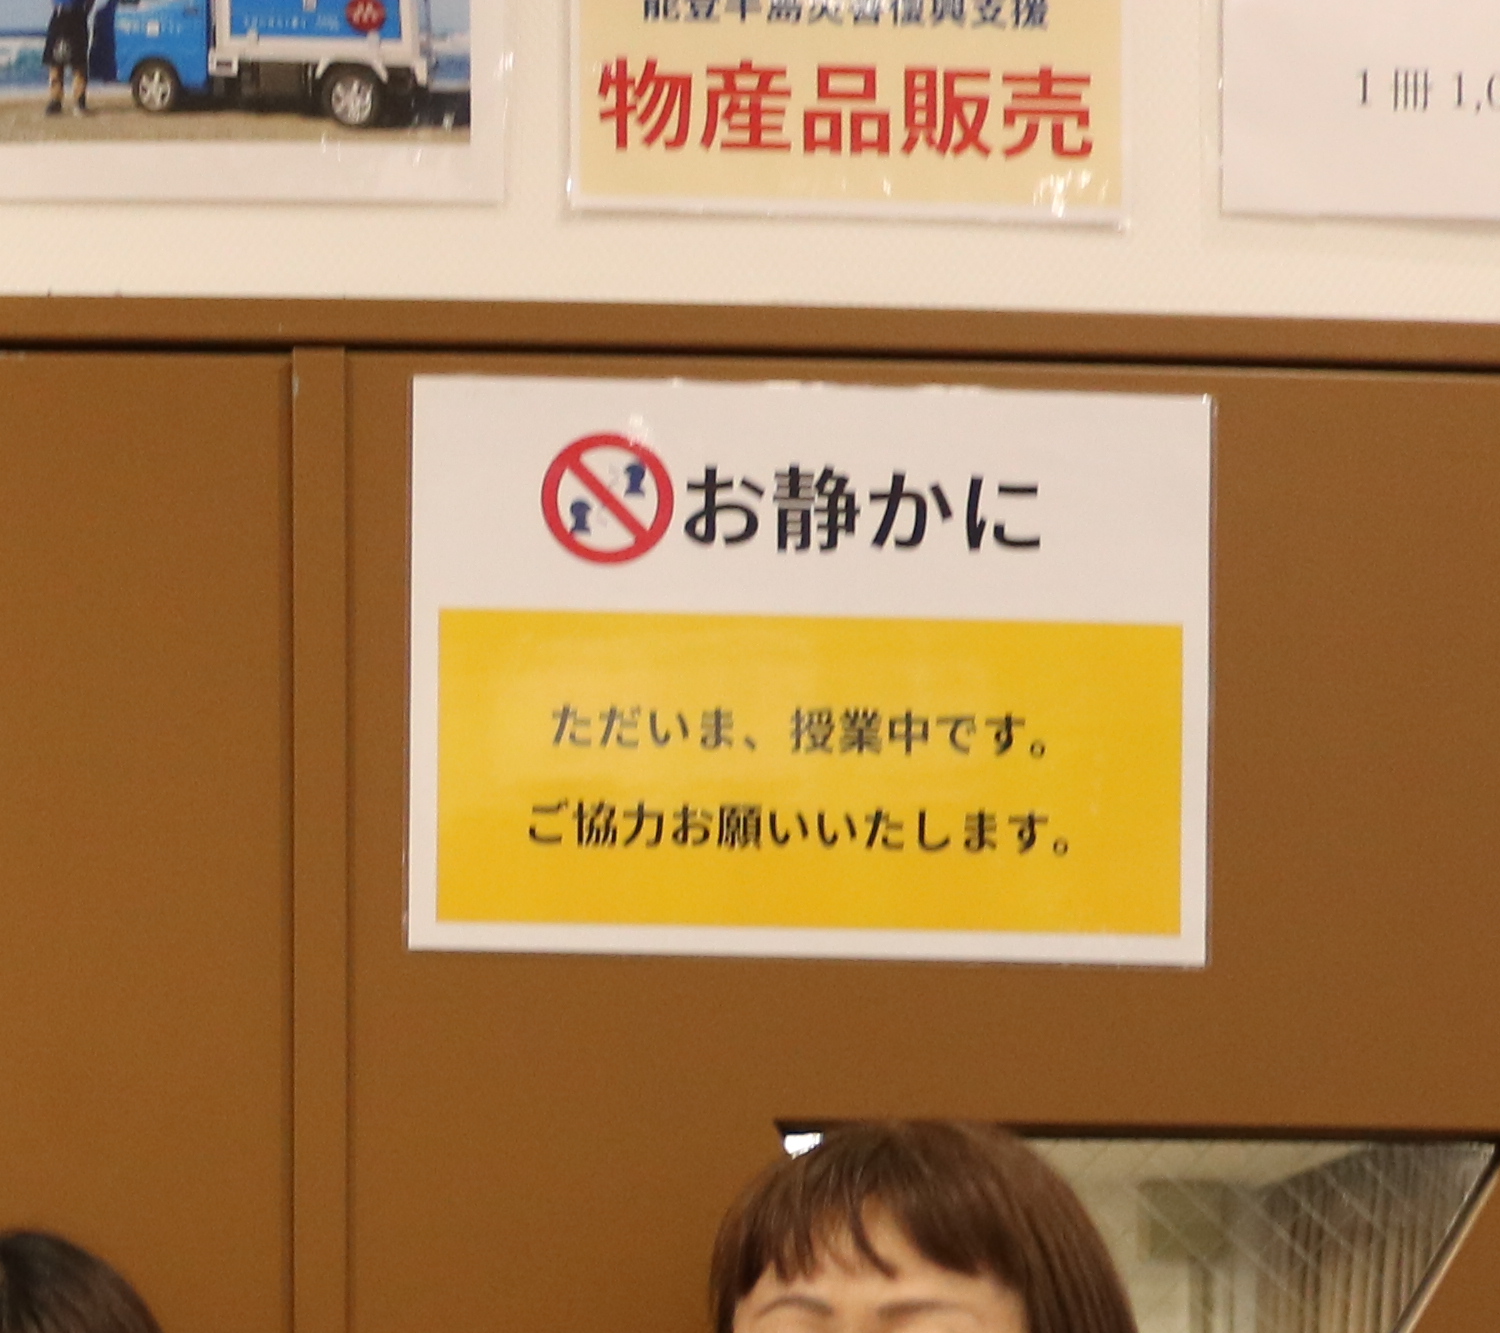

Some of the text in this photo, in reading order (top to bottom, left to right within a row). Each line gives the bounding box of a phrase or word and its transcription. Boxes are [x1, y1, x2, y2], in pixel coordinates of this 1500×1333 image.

[597, 55, 1095, 161] 物産品販売
[683, 461, 1042, 554] お静かに
[550, 702, 1048, 759] ただいま、授業中です。
[526, 798, 1071, 858] ご協力お願いいたします。
